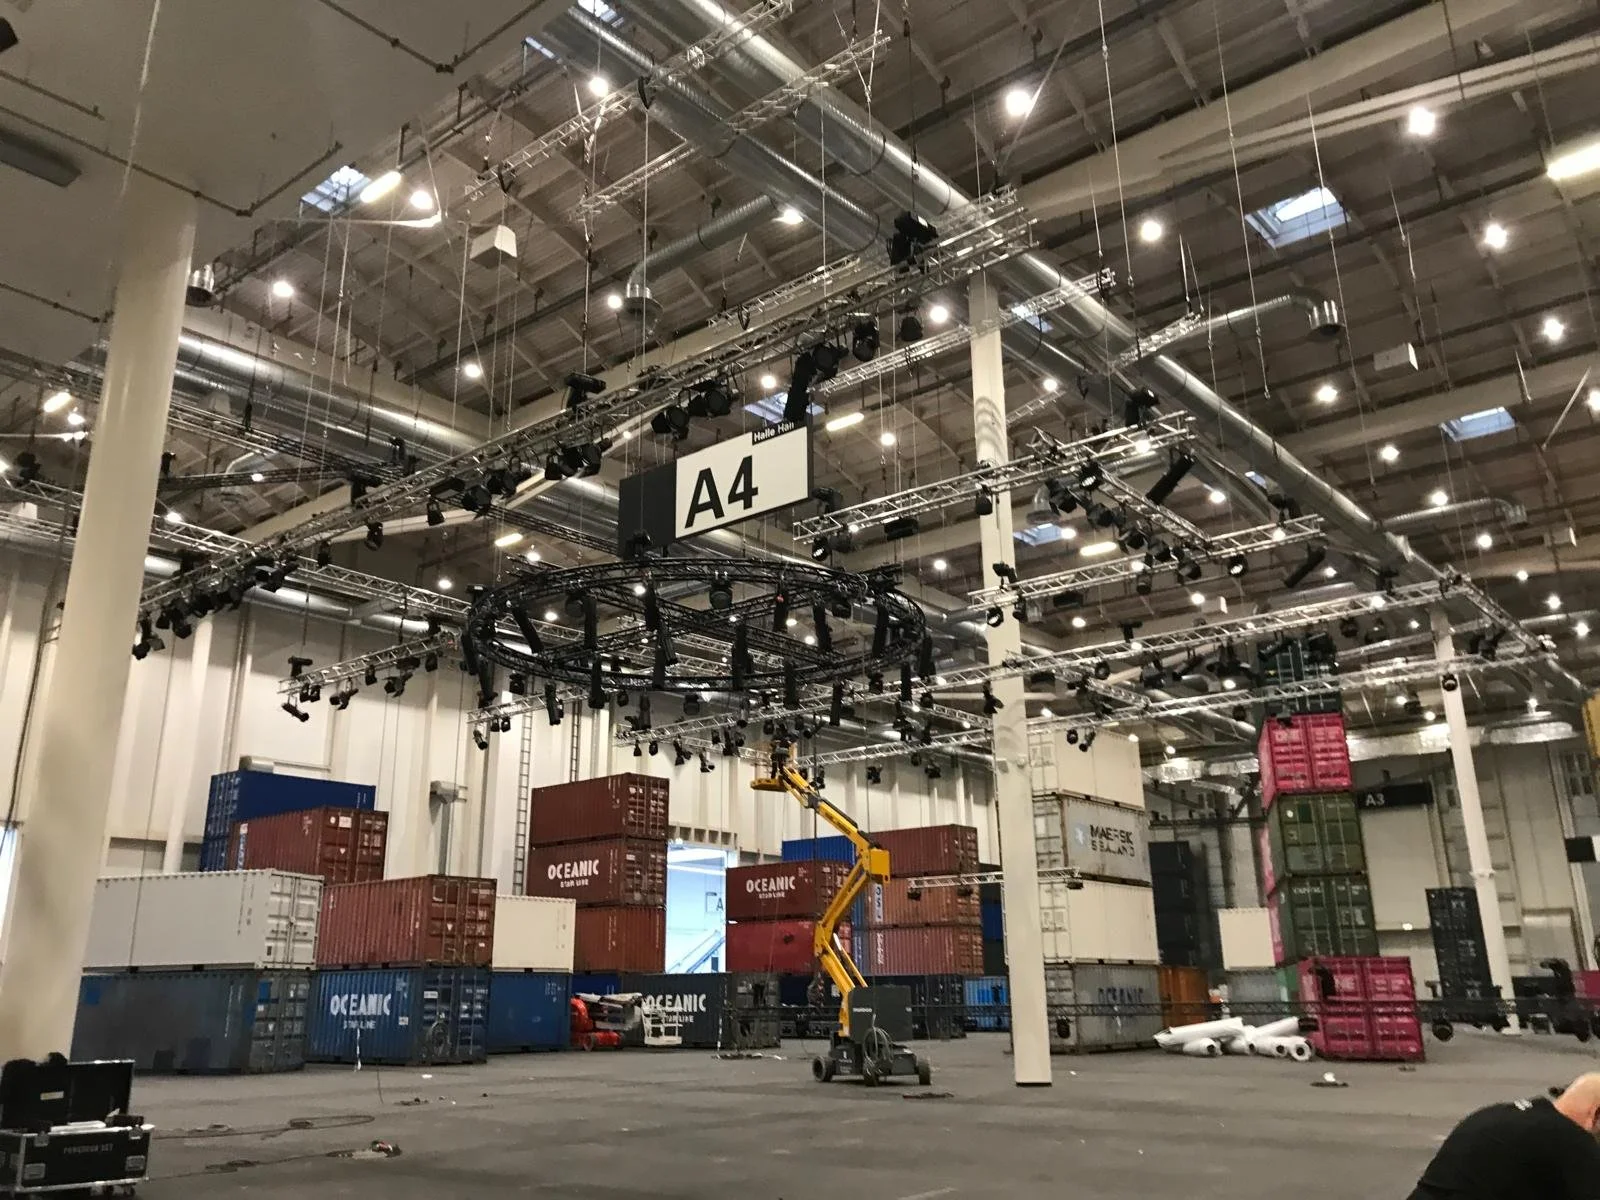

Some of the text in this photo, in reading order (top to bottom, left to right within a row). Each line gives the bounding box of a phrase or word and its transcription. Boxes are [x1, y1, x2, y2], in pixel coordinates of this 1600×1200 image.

[754, 421, 794, 442] Halle Hall
[684, 455, 759, 529] A4
[1365, 794, 1385, 807] A3
[547, 859, 600, 880] OCEANIC
[746, 875, 796, 893] OCEANIC
[330, 993, 392, 1016] OCEANIC
[645, 993, 707, 1012] OCEANIC
